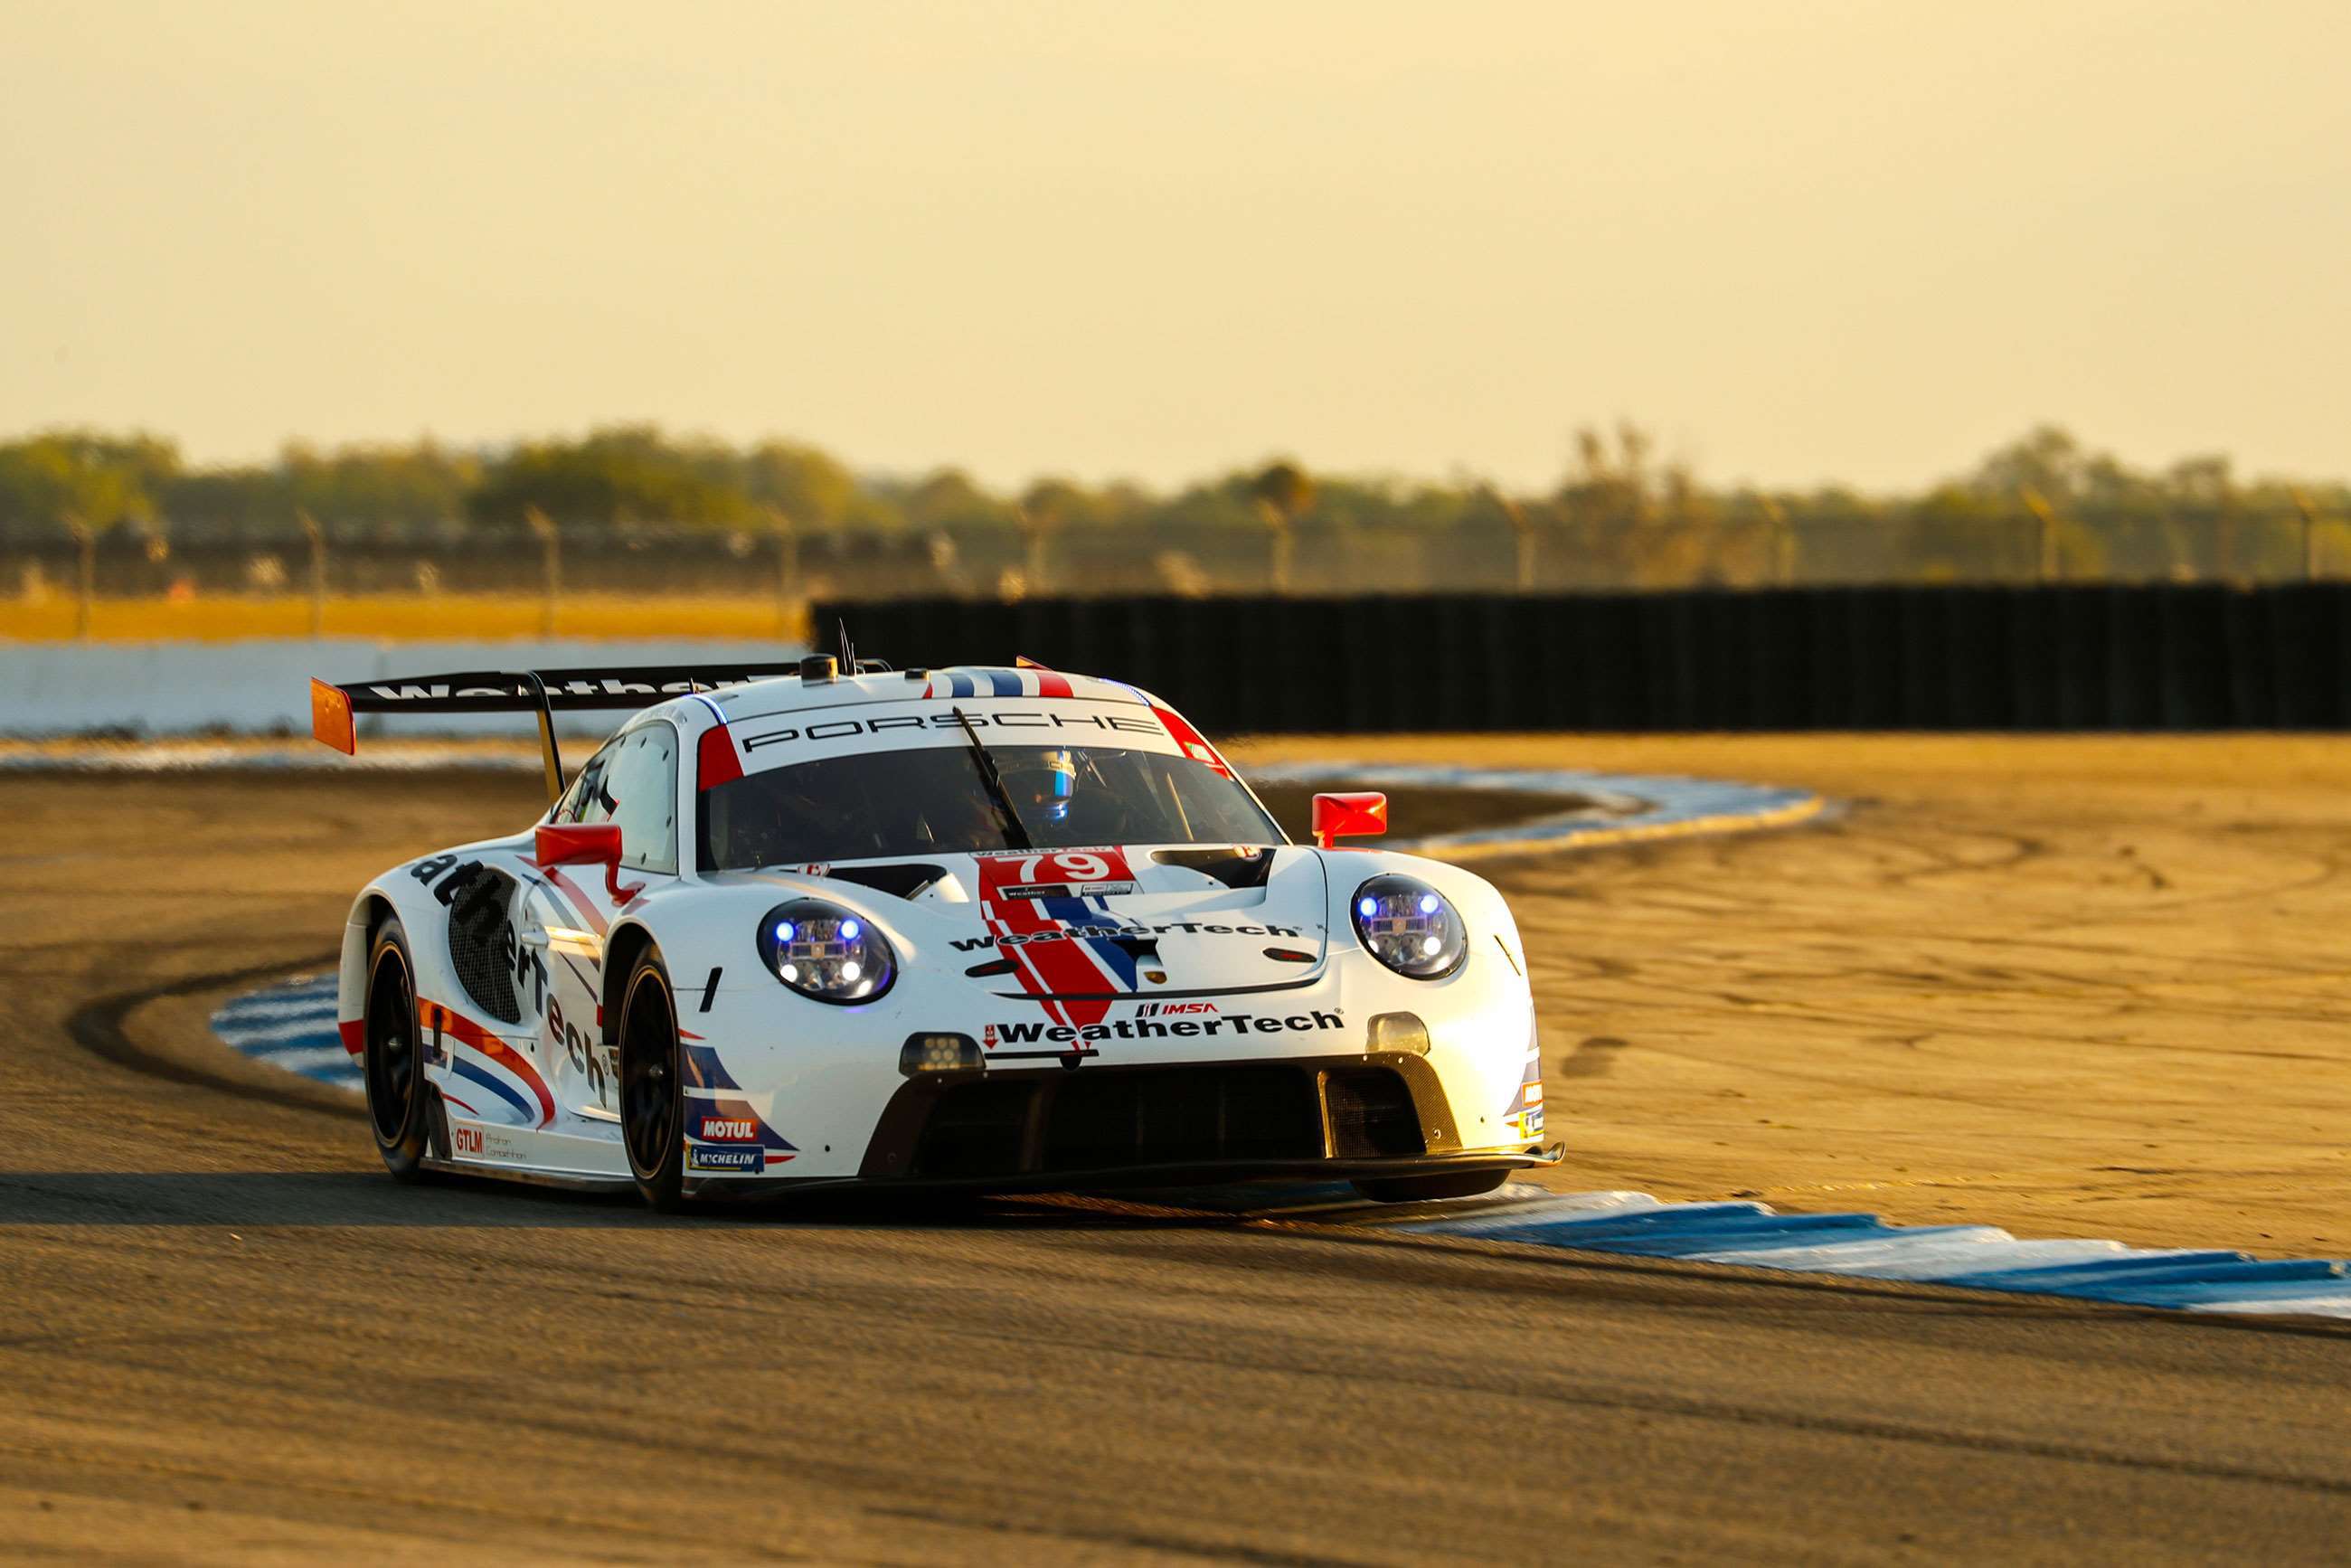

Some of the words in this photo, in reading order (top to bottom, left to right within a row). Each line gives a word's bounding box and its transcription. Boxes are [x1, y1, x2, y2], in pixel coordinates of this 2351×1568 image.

[741, 713, 1165, 752] PORSCHE
[995, 852, 1110, 883] 79
[1161, 1002, 1219, 1015] IMSA
[703, 1120, 754, 1138] MOTUL
[456, 1128, 483, 1154] GTLM
[699, 1153, 755, 1165] MICHELIN
